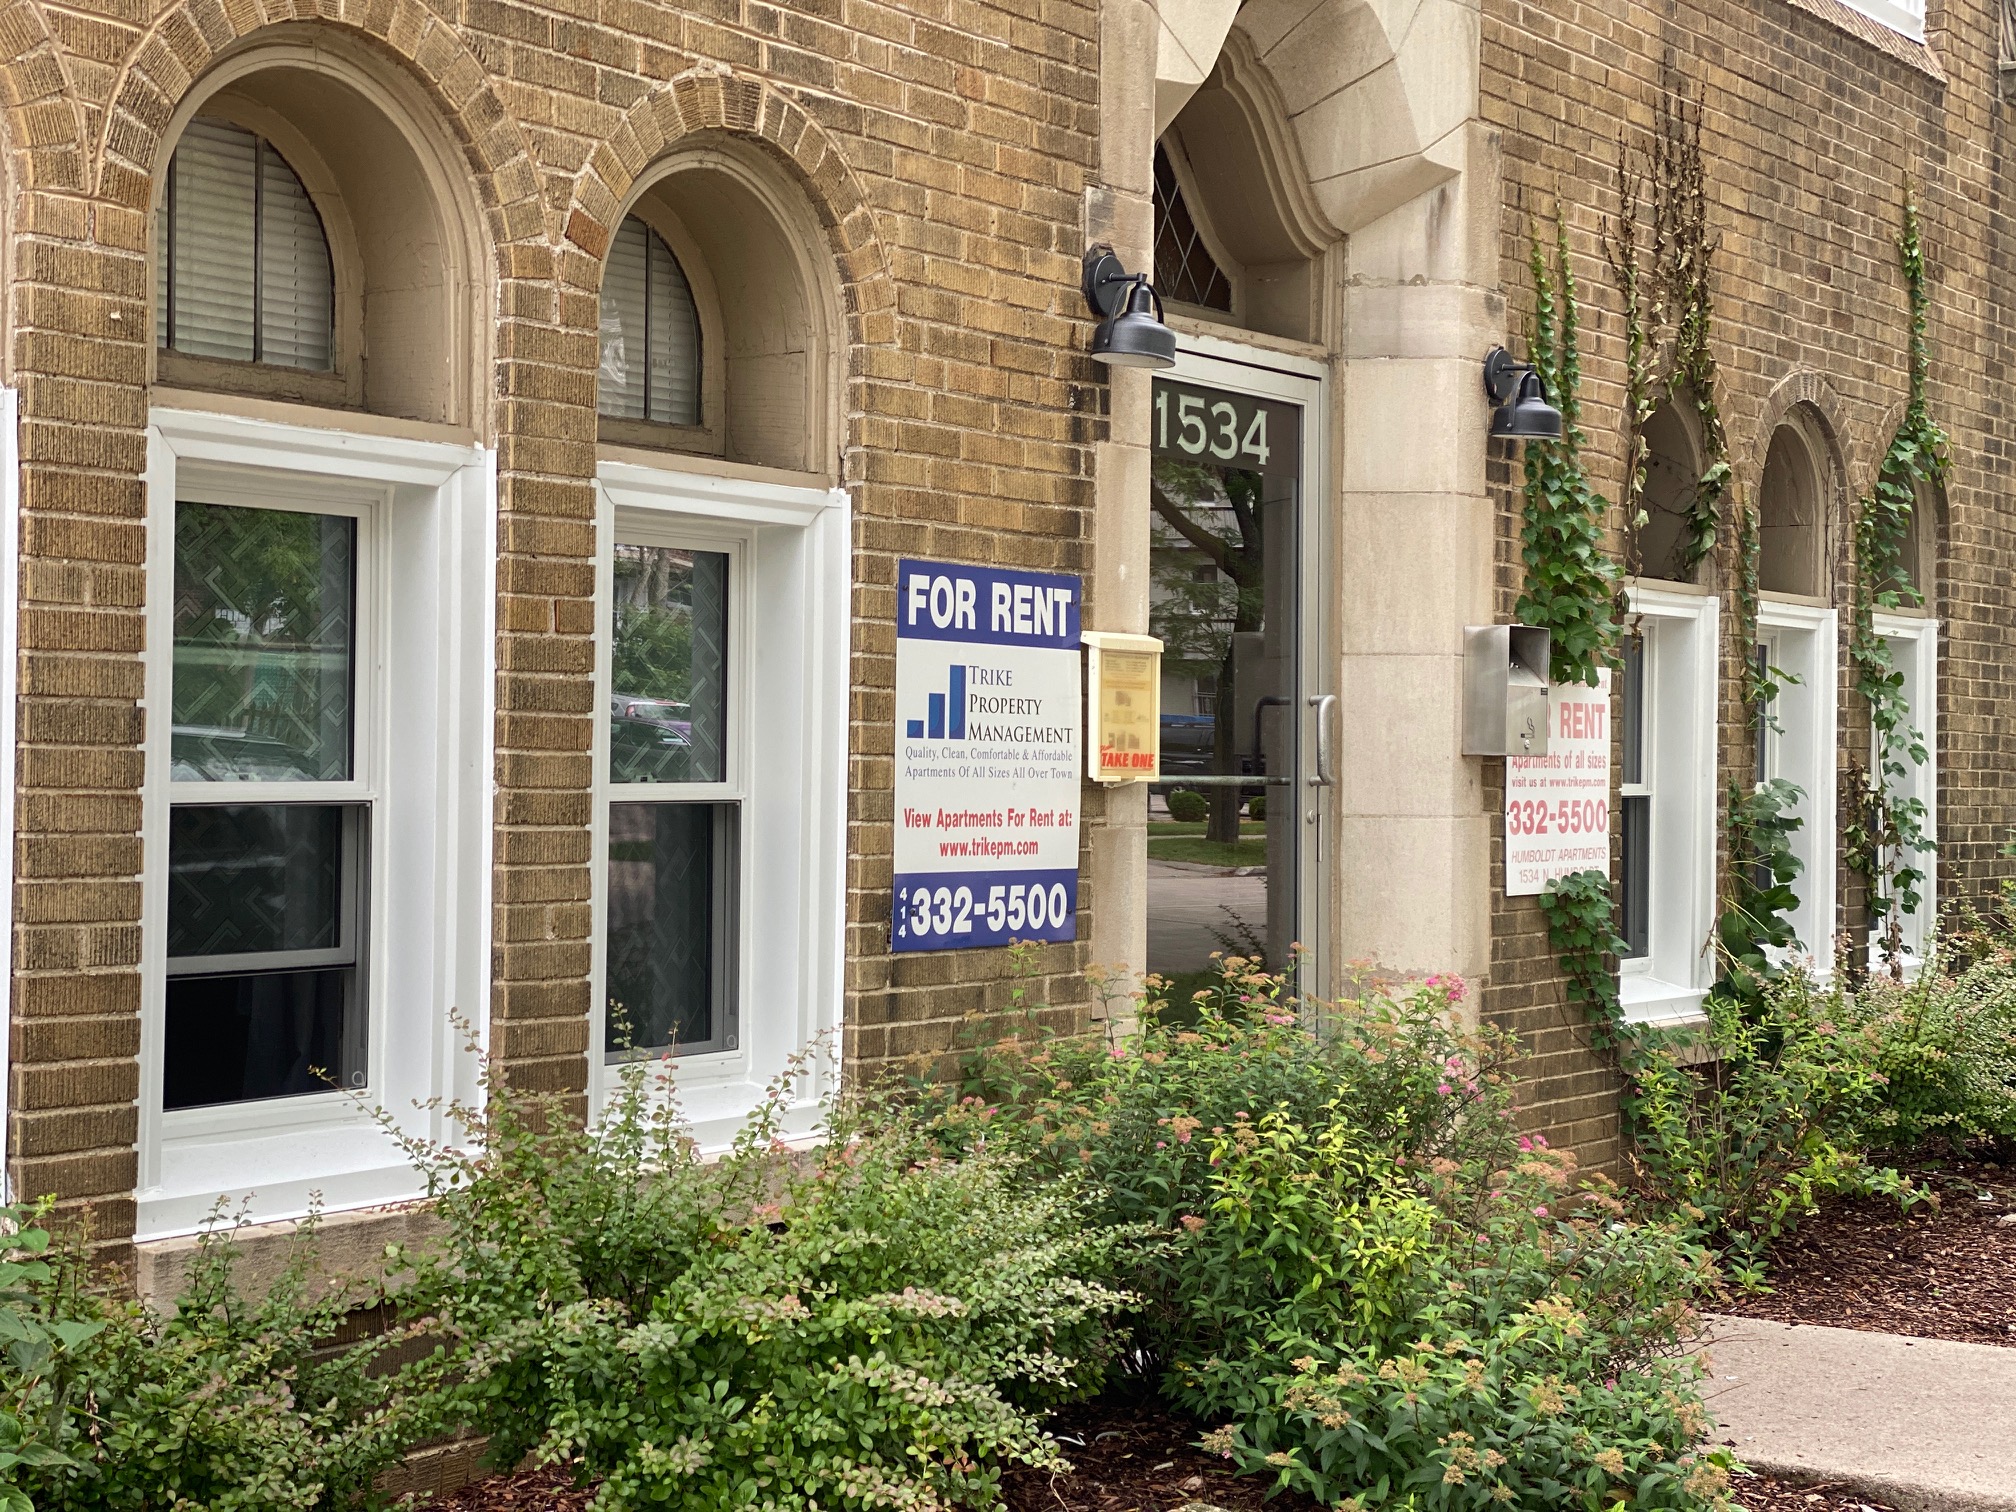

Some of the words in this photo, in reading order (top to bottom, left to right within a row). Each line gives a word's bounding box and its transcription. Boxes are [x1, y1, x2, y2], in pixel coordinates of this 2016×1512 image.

[1156, 390, 1270, 465] 1534
[908, 574, 976, 630] FOR
[991, 582, 1072, 637] RENT
[969, 665, 1013, 686] TRIKE
[969, 694, 1042, 715] PROPERTY
[1560, 702, 1606, 739] RENT
[968, 722, 1073, 744] MANAGEMENT
[905, 746, 939, 761] Quality,
[941, 747, 968, 760] Clean,
[970, 747, 1019, 761] Comfortable
[1022, 750, 1029, 760] &
[1031, 749, 1073, 762] Affordable
[1101, 752, 1129, 767] TAKE
[1132, 753, 1155, 768] ONE
[1512, 752, 1560, 772] Apartments
[1564, 750, 1573, 769] of
[1575, 750, 1585, 769] all
[1587, 751, 1606, 769] sizes
[905, 765, 956, 780] Apartments
[958, 766, 971, 777] Of
[972, 766, 985, 778] All
[988, 767, 1010, 778] Sizes
[1012, 767, 1025, 779] All
[1028, 767, 1048, 779] Over
[1050, 768, 1073, 779] Town
[1512, 776, 1527, 788] visit
[1529, 778, 1537, 788] us
[1540, 777, 1547, 787] at
[1549, 776, 1606, 789] www.trikepm.com
[904, 808, 931, 828] View
[936, 808, 1003, 831] Apartments
[1007, 808, 1025, 827] For
[1029, 808, 1054, 827] Rent
[1058, 809, 1072, 827] at:
[1509, 799, 1607, 835] 332-5500
[939, 836, 1039, 859] www.trikepm.com
[1512, 849, 1556, 863] HUMBOLDT
[1558, 847, 1607, 861] APARTMENTS
[1519, 868, 1539, 883] 1534
[910, 882, 1067, 936] 332-5500
